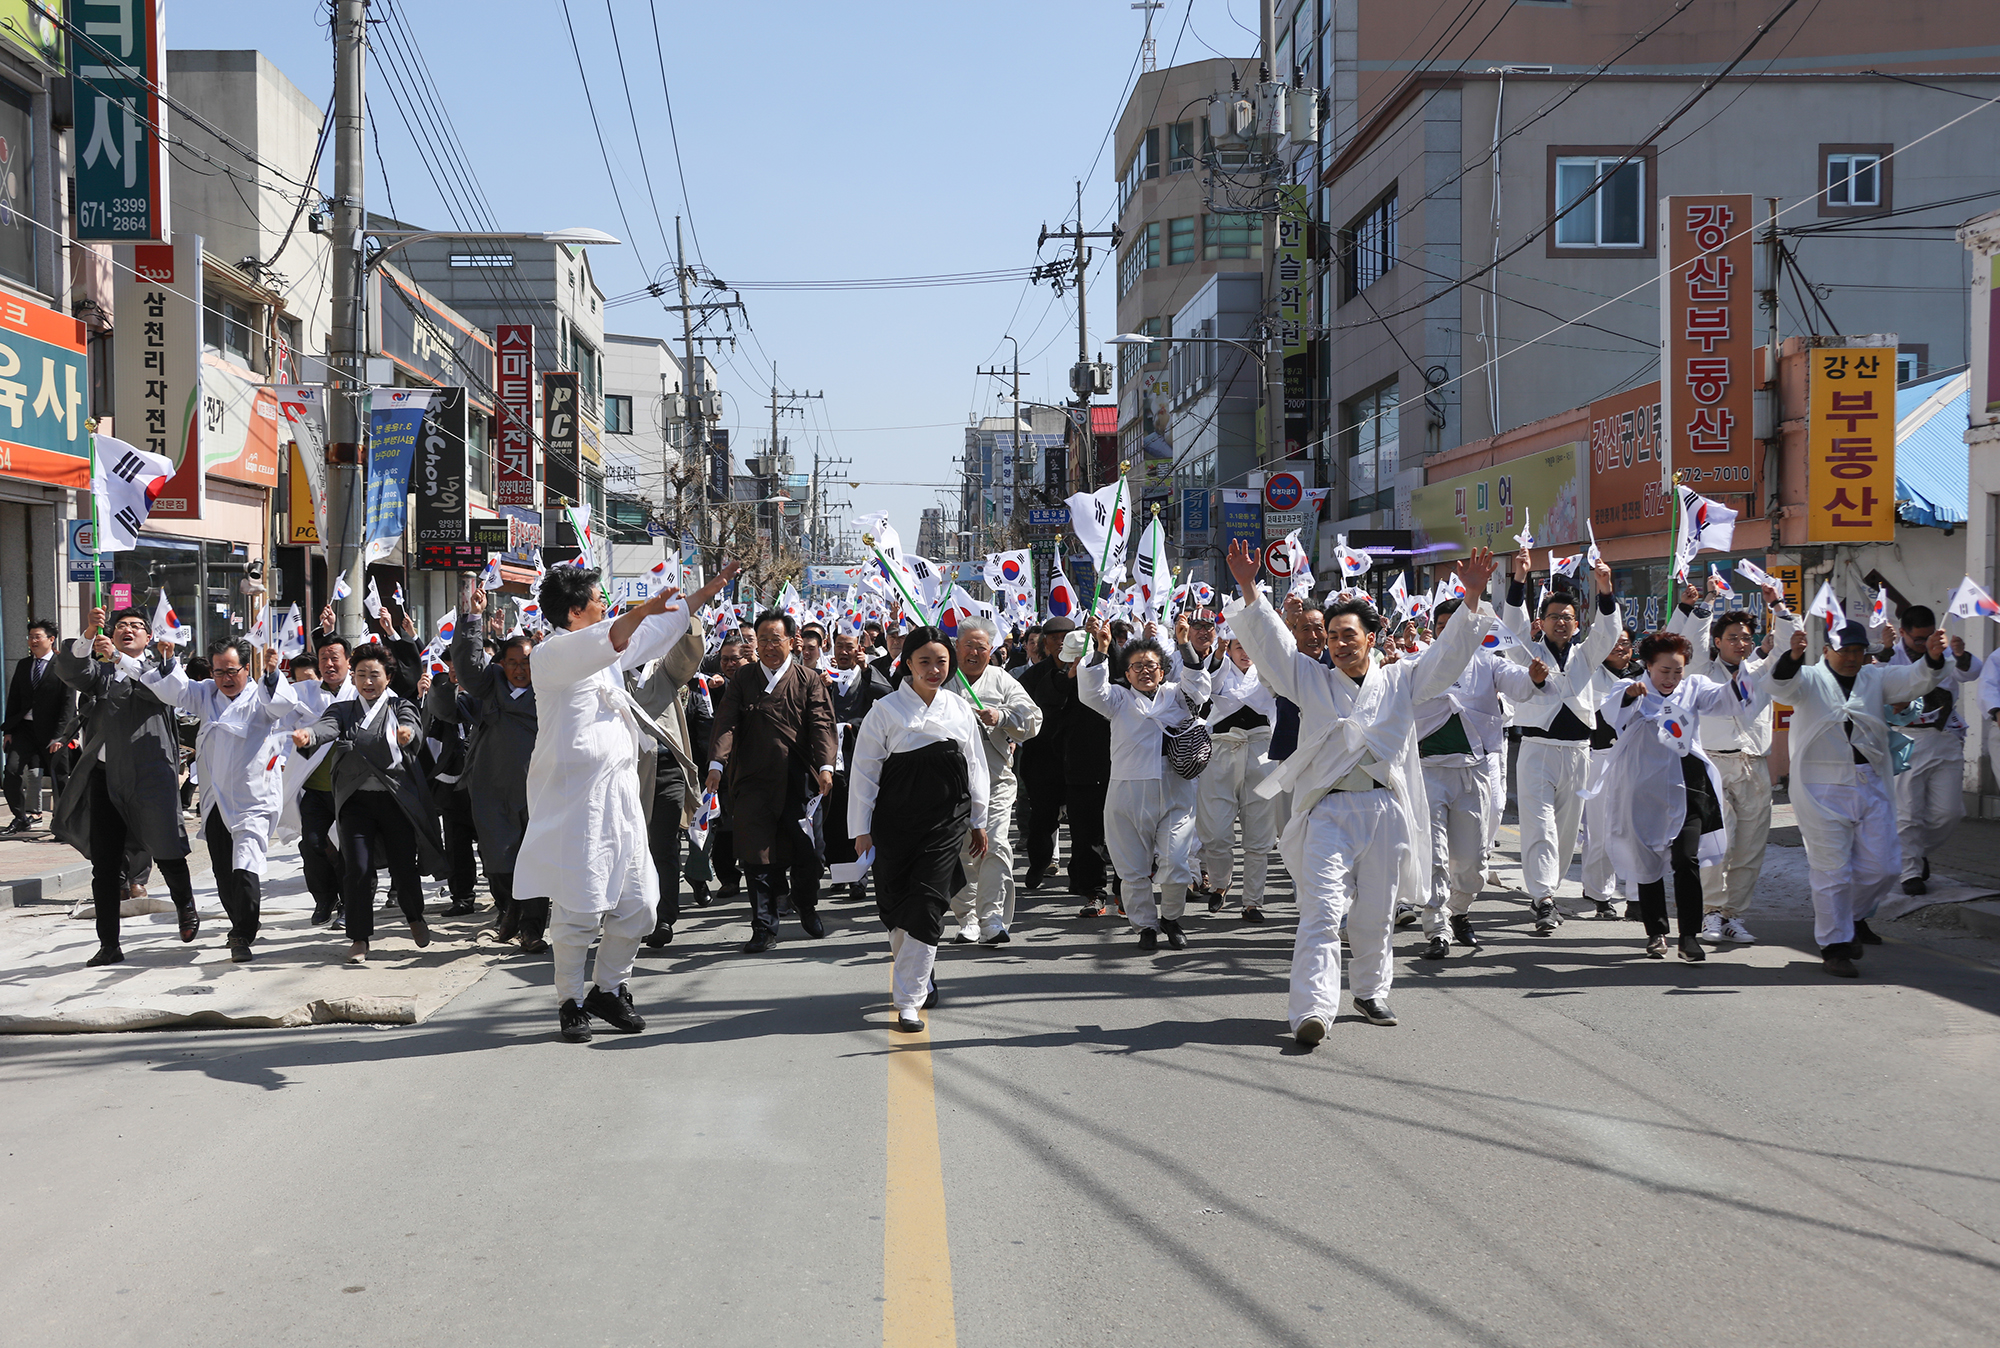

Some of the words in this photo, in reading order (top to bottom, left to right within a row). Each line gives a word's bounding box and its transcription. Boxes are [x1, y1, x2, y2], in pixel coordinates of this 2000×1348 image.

[80, 201, 113, 228] 671-
[112, 198, 147, 213] 3399
[112, 215, 147, 231] 2864
[1280, 220, 1302, 347] 한슬학원
[1686, 204, 1734, 453] 강산부동산
[143, 292, 168, 457] 삼천리자전거
[1823, 356, 1880, 379] 강산
[502, 330, 529, 478] 스마트자전거
[258, 464, 275, 475] CELLO
[1822, 390, 1879, 527] 부동산
[499, 480, 532, 494] 양양대리점
[420, 530, 462, 538] 672-5757
[438, 520, 462, 528] 양양점
[1625, 596, 1659, 633] 강산
